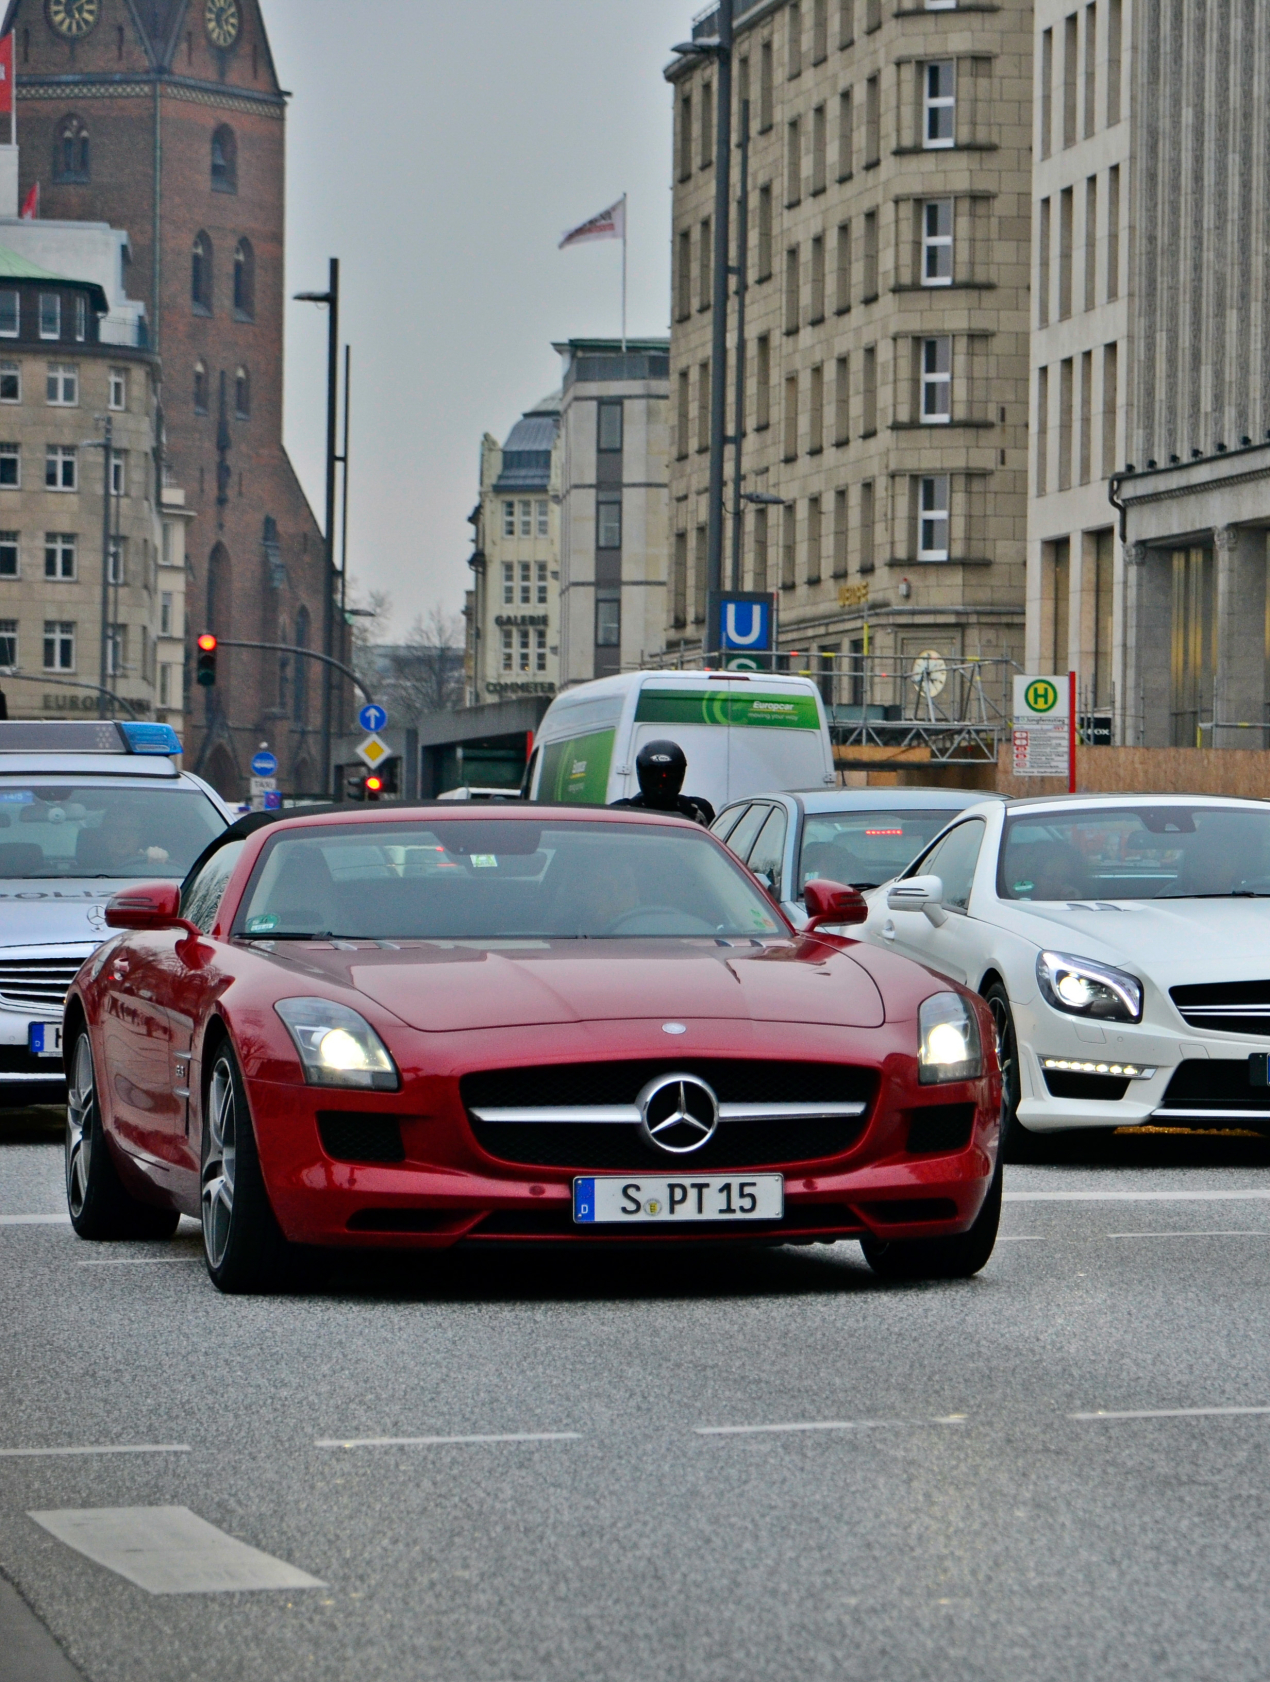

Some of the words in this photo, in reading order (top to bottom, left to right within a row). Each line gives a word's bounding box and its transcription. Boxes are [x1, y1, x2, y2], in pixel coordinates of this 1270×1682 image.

[494, 615, 549, 627] GALERIE
[727, 603, 761, 645] U
[485, 681, 556, 694] COMMETER
[1033, 686, 1048, 705] H
[753, 701, 794, 712] Europcar
[0, 890, 117, 899] OLIZ
[620, 1183, 642, 1215] S
[667, 1182, 711, 1215] PT
[718, 1181, 757, 1214] 15
[580, 1203, 589, 1214] D
